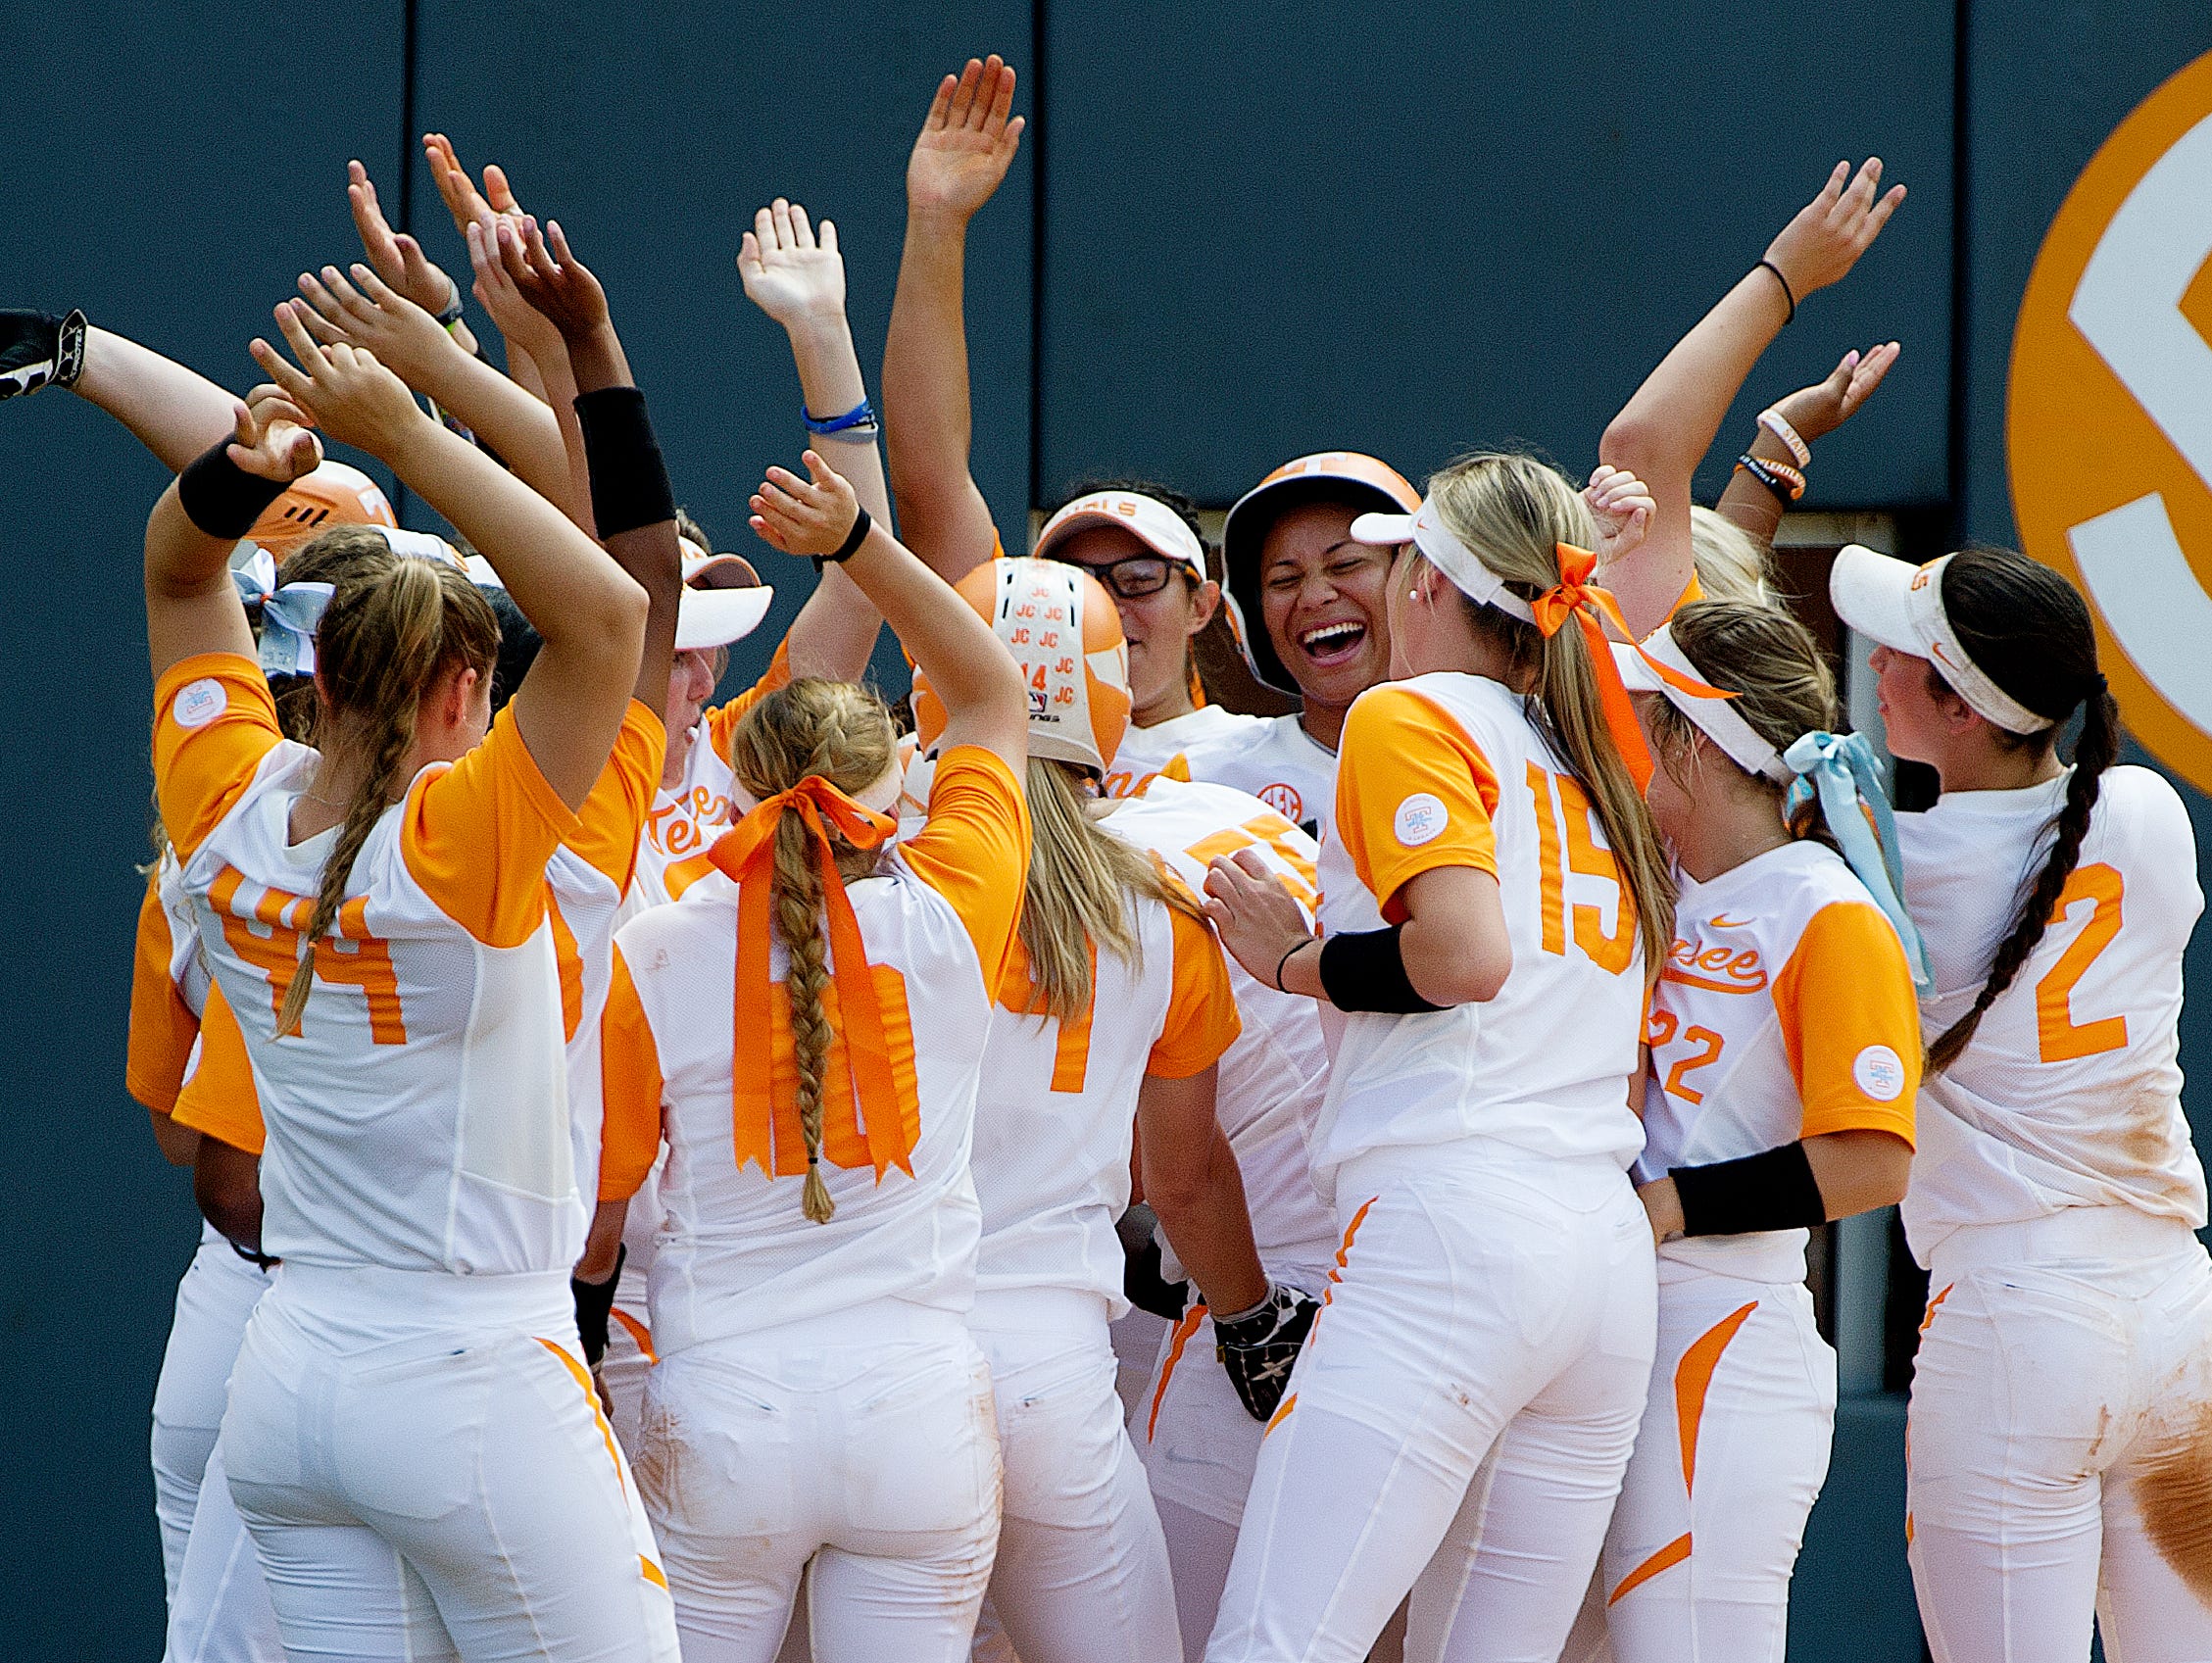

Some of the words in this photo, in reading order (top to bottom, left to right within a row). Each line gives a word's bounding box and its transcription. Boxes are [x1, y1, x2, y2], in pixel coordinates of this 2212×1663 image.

[1015, 604, 1036, 618] JC
[1044, 606, 1062, 621] JC
[1010, 628, 1030, 645] JC
[1039, 631, 1058, 649] JC
[1055, 657, 1074, 674] JC
[1054, 686, 1074, 704] JC
[1526, 758, 1641, 975] 15
[208, 863, 409, 1047] 44
[2035, 861, 2129, 1064] 2
